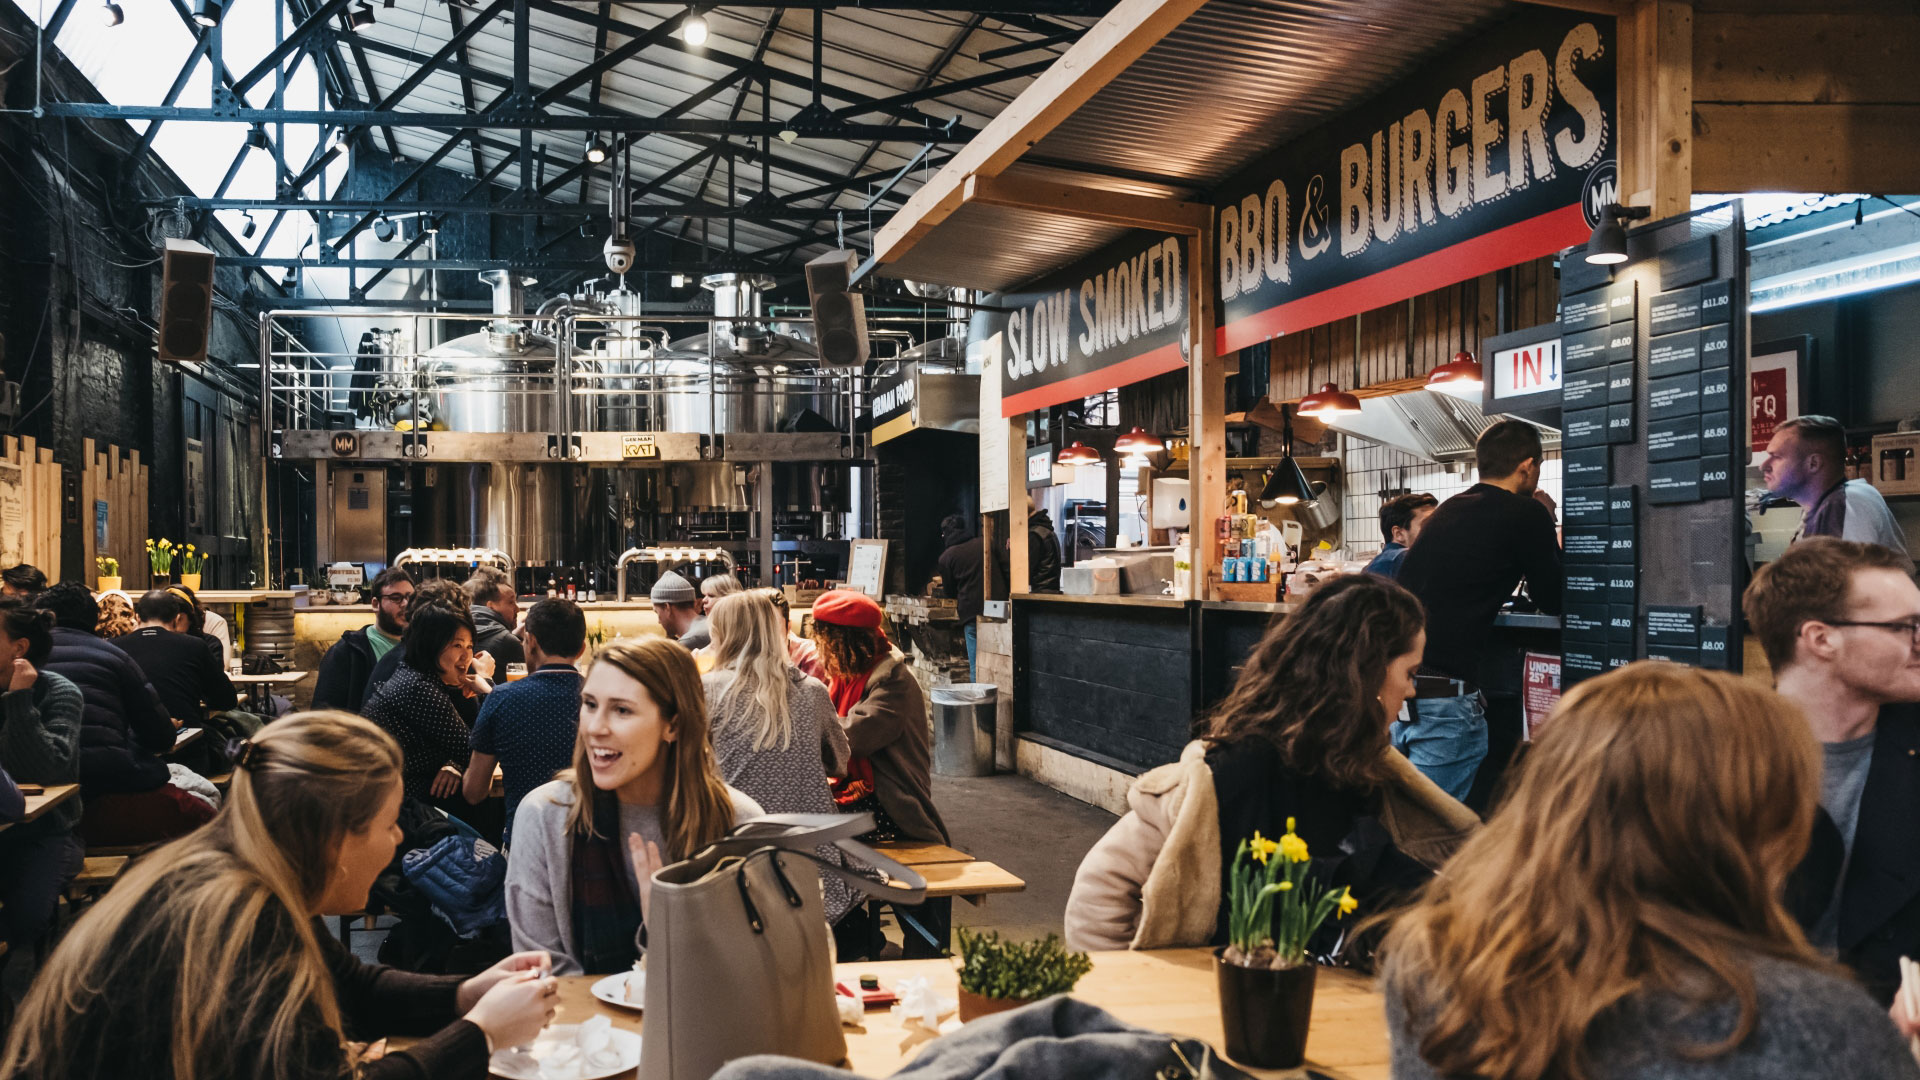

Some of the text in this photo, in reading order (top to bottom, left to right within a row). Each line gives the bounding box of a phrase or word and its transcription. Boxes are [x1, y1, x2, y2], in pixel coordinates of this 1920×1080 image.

[1220, 22, 1609, 303] BBQ & BURGERS
[1007, 236, 1182, 381] SLOW SMOKED
[1513, 347, 1543, 390] IN
[895, 378, 915, 408] FOOD
[335, 437, 354, 451] MM
[624, 443, 653, 456] KRAFT
[1030, 458, 1046, 477] OUT
[1528, 660, 1561, 676] UNDER
[1528, 671, 1545, 684] 25?
